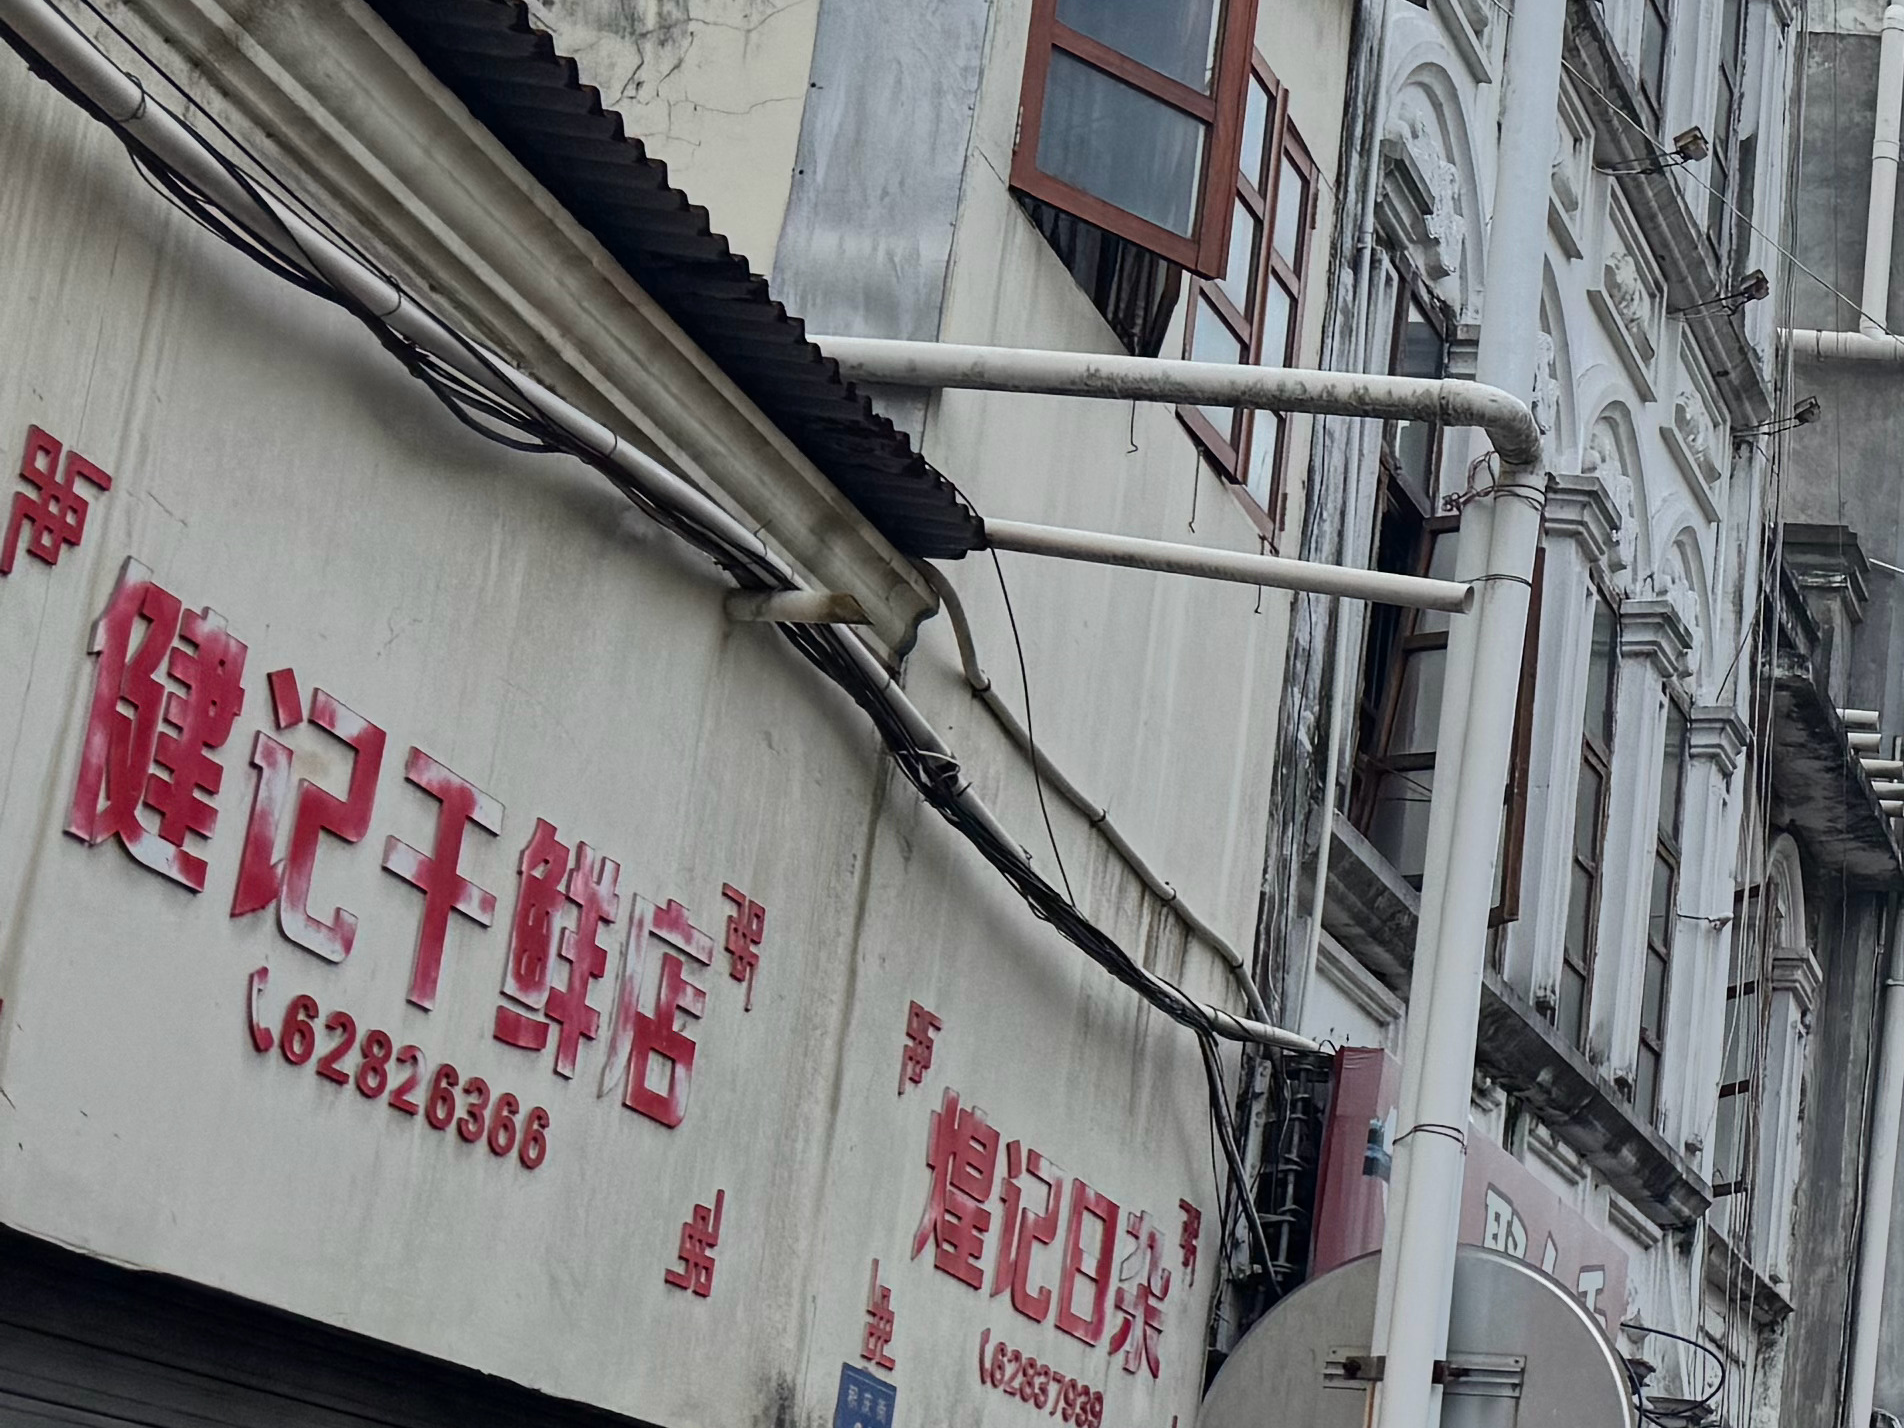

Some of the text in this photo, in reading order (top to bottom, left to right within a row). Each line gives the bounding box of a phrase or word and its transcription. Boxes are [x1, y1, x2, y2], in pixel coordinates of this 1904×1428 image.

[63, 556, 715, 1129] 健记干鲜店
[282, 993, 549, 1170] 62826366
[911, 1086, 1172, 1380] 煌记日杂
